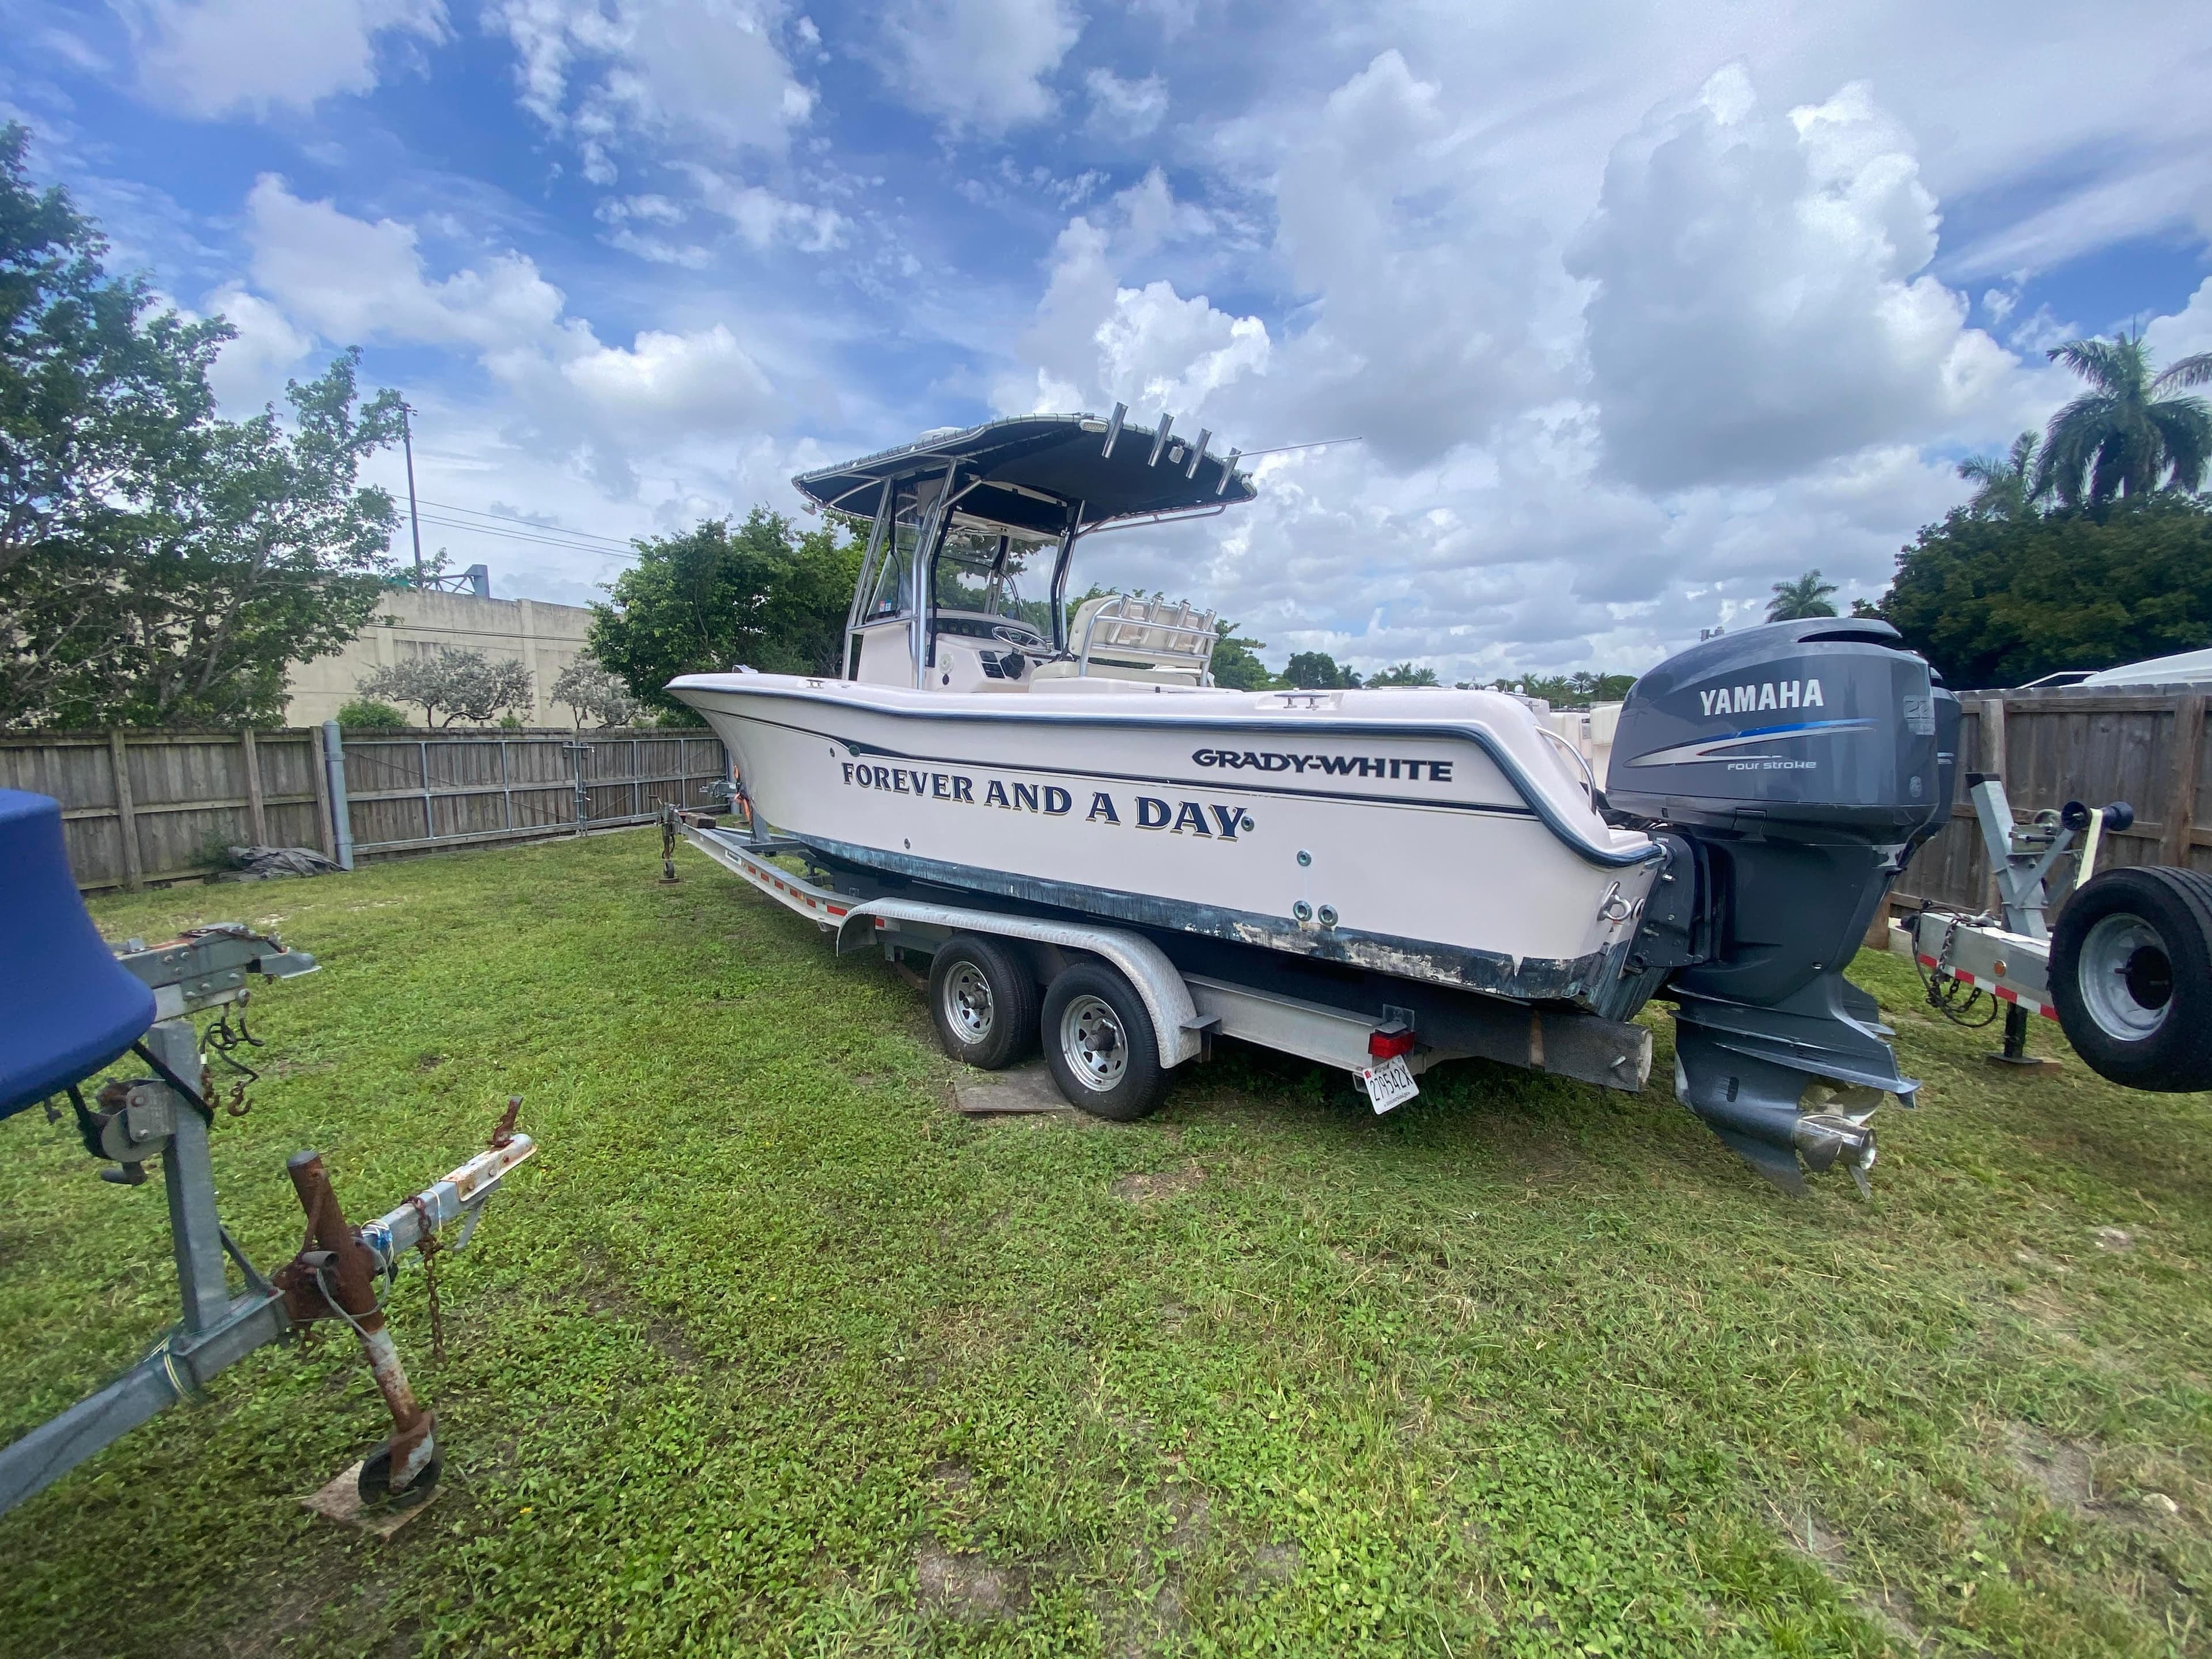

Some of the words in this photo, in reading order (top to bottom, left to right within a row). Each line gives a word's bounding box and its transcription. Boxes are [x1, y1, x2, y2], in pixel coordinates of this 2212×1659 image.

[1700, 679, 1825, 717] YAMAHA
[1192, 748, 1453, 782] GRADY-WHITE
[841, 762, 975, 805] FOREVER
[983, 779, 1073, 816] AND
[1085, 791, 1122, 826] A
[1134, 796, 1248, 842] DAY
[1370, 1065, 1413, 1101] 279542X
